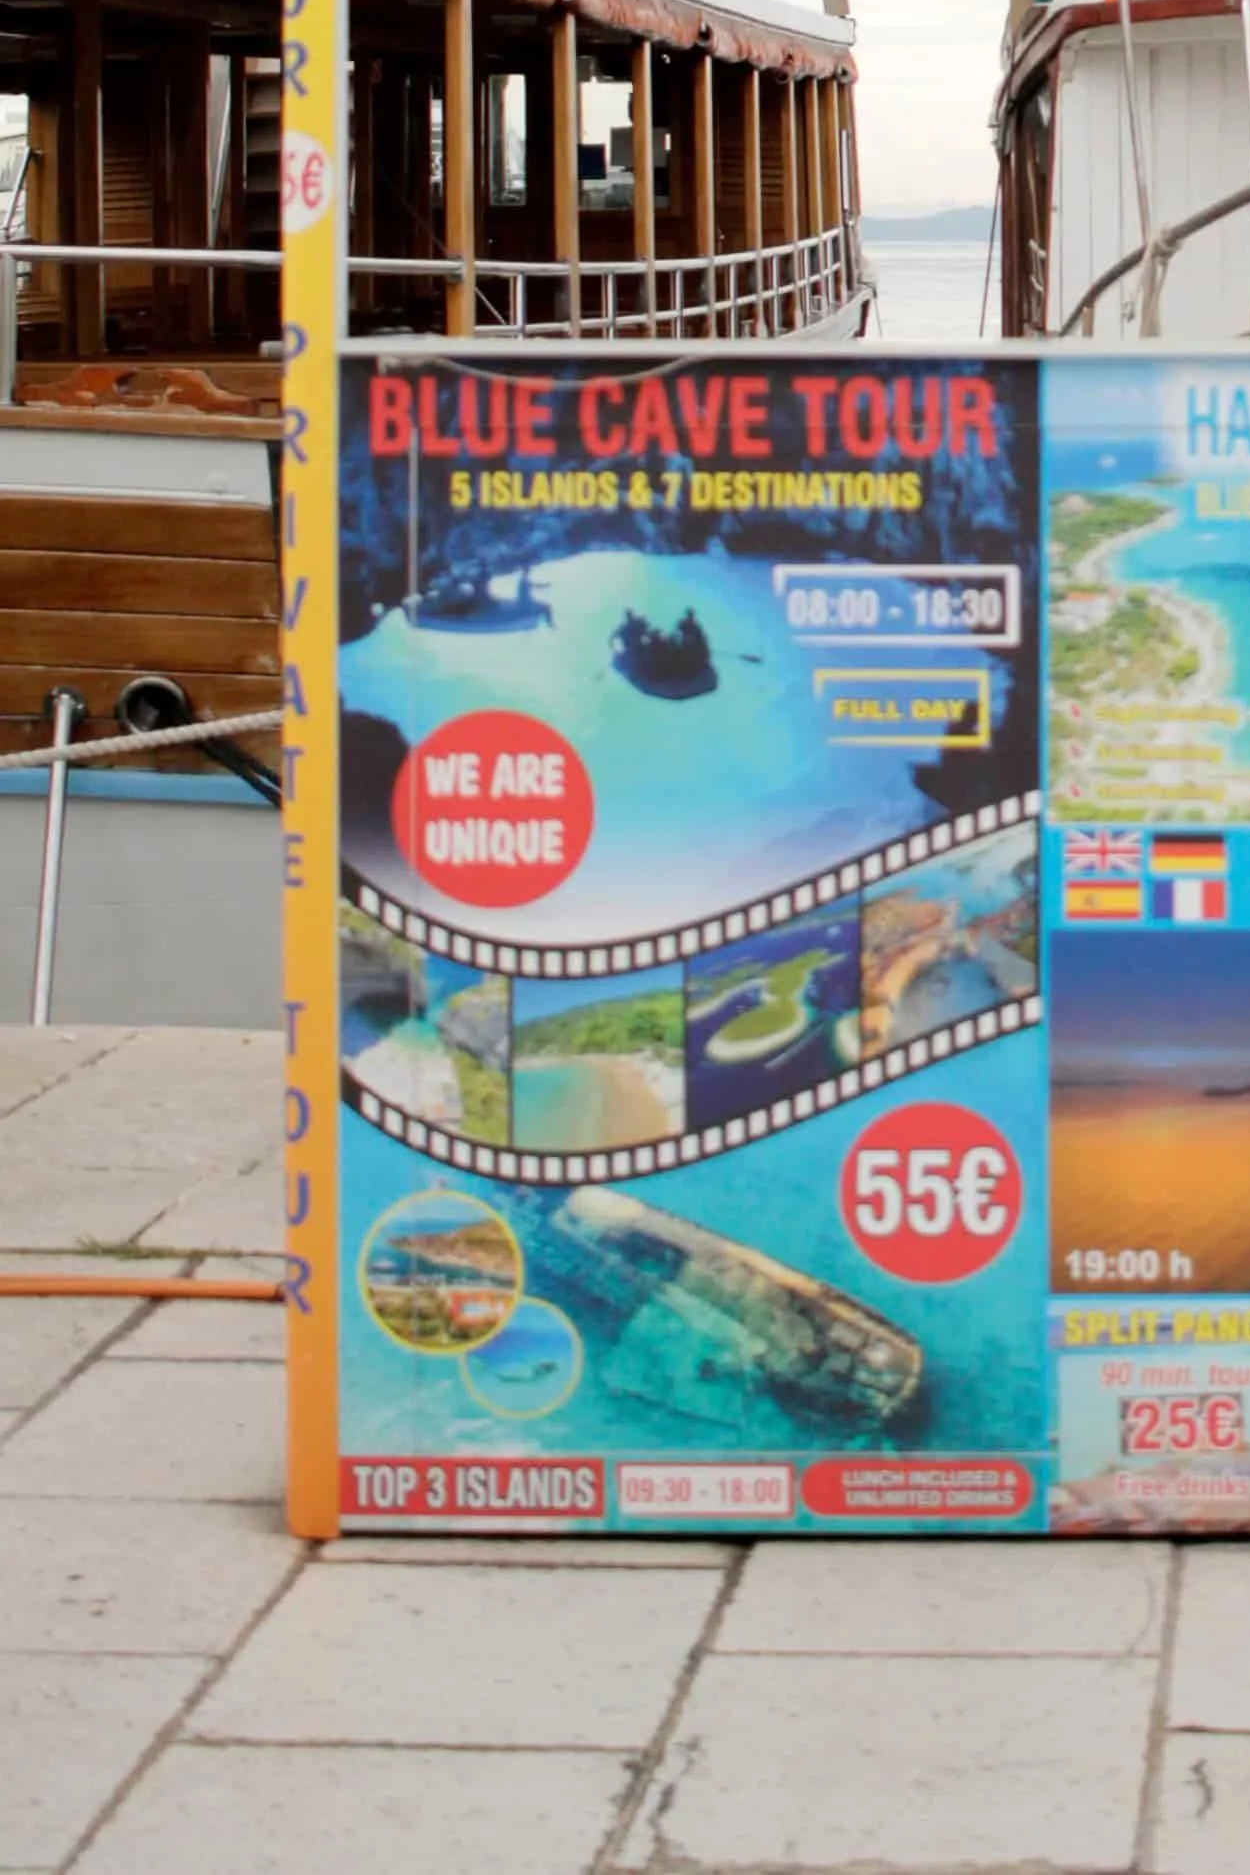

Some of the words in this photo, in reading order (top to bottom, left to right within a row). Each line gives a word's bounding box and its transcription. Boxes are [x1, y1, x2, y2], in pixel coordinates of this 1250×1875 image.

[368, 377, 556, 456] BLUE
[579, 376, 772, 457] CAVE
[794, 376, 999, 458] TOUR
[450, 471, 471, 510] 5
[479, 471, 619, 510] ISLANDS
[628, 472, 650, 510] &
[662, 472, 680, 510] 7
[690, 471, 922, 511] DESTINATIONS
[787, 588, 880, 627] 08:00
[832, 698, 902, 720] FULL
[909, 698, 967, 721] DAY
[425, 753, 480, 797] WE
[490, 753, 566, 797] ARE
[425, 818, 564, 865] UNIQUE
[853, 1145, 1009, 1239] 55€
[1064, 1247, 1161, 1282] 19:00
[1168, 1247, 1195, 1281] h
[1064, 1309, 1160, 1344] SPLIT
[1101, 1362, 1134, 1386] 90
[1128, 1397, 1239, 1453] 25€
[351, 1464, 418, 1509] TOP
[425, 1464, 446, 1509] 3
[455, 1464, 596, 1509] ISLANDS
[624, 1475, 693, 1505] 09:30
[716, 1474, 783, 1505] 18:00
[1116, 1474, 1169, 1497] Free
